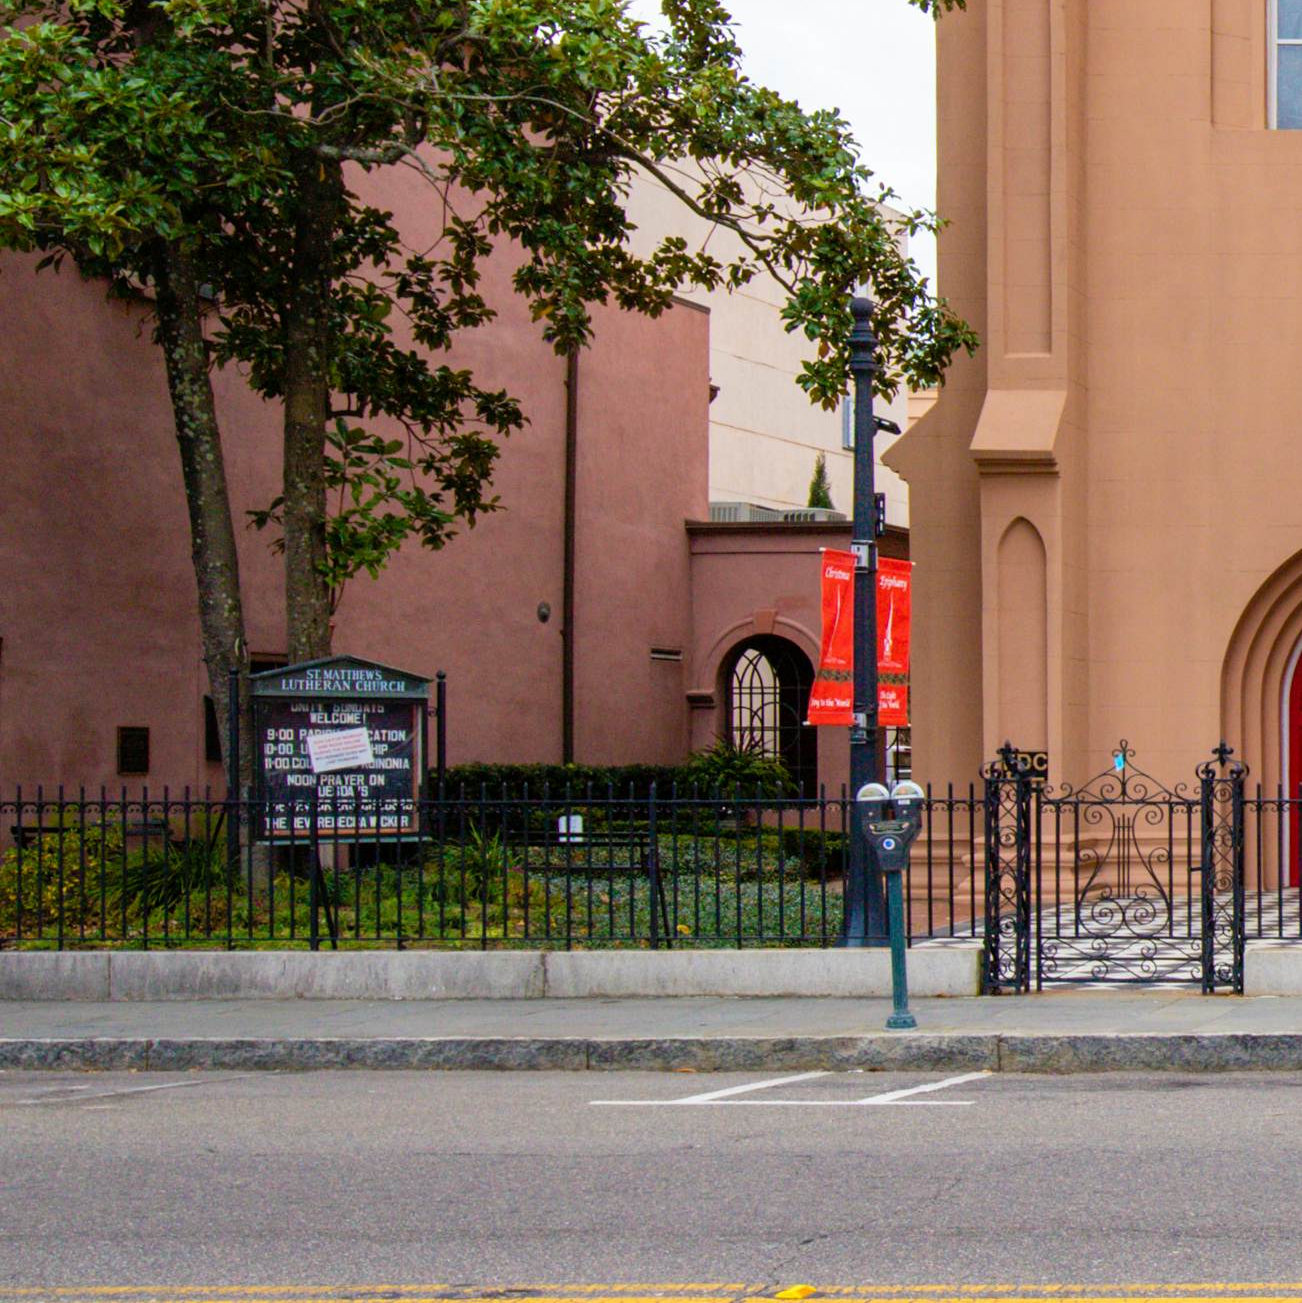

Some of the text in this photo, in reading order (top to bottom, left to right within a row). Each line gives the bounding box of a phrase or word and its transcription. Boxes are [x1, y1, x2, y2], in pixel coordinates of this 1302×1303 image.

[282, 679, 406, 693] LUTHERAN CHURCH
[310, 712, 366, 724] WELCOME!
[287, 774, 385, 786] NOON PRAYER ON
